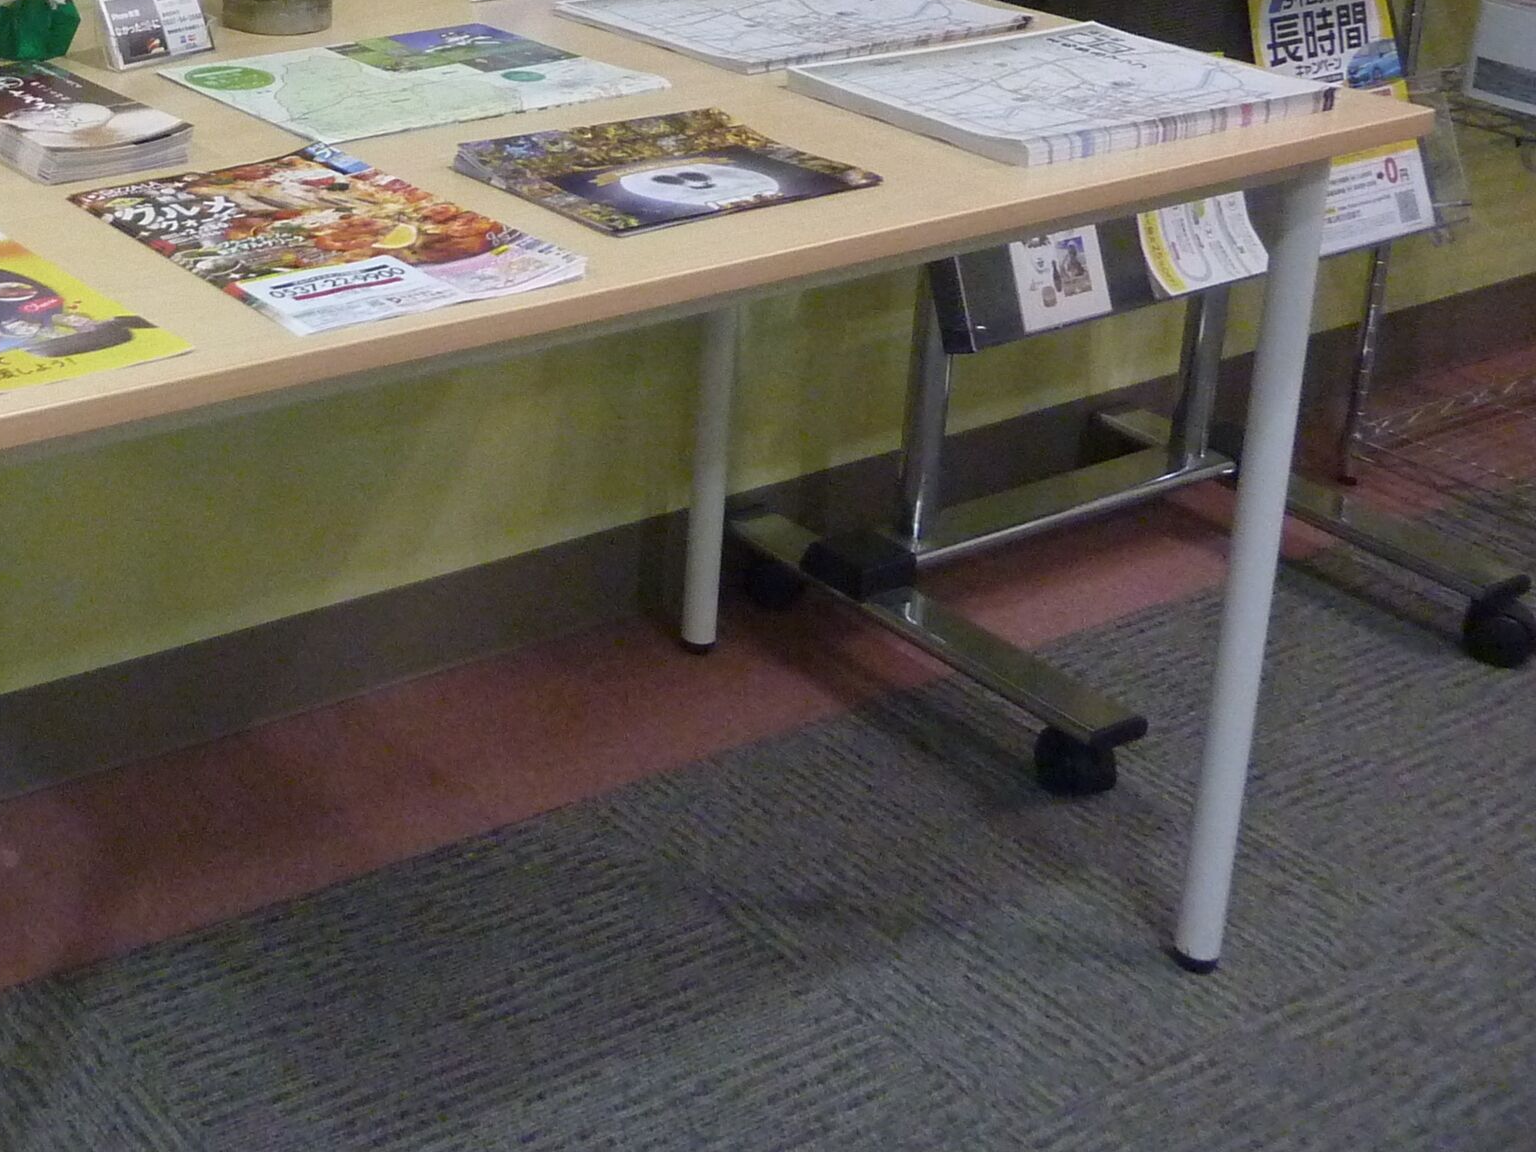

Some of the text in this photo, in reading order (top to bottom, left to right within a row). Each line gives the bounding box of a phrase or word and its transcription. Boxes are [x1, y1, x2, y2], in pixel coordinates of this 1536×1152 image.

[1266, 0, 1370, 67] 長時間
[268, 266, 406, 301] 0537-22-9900
